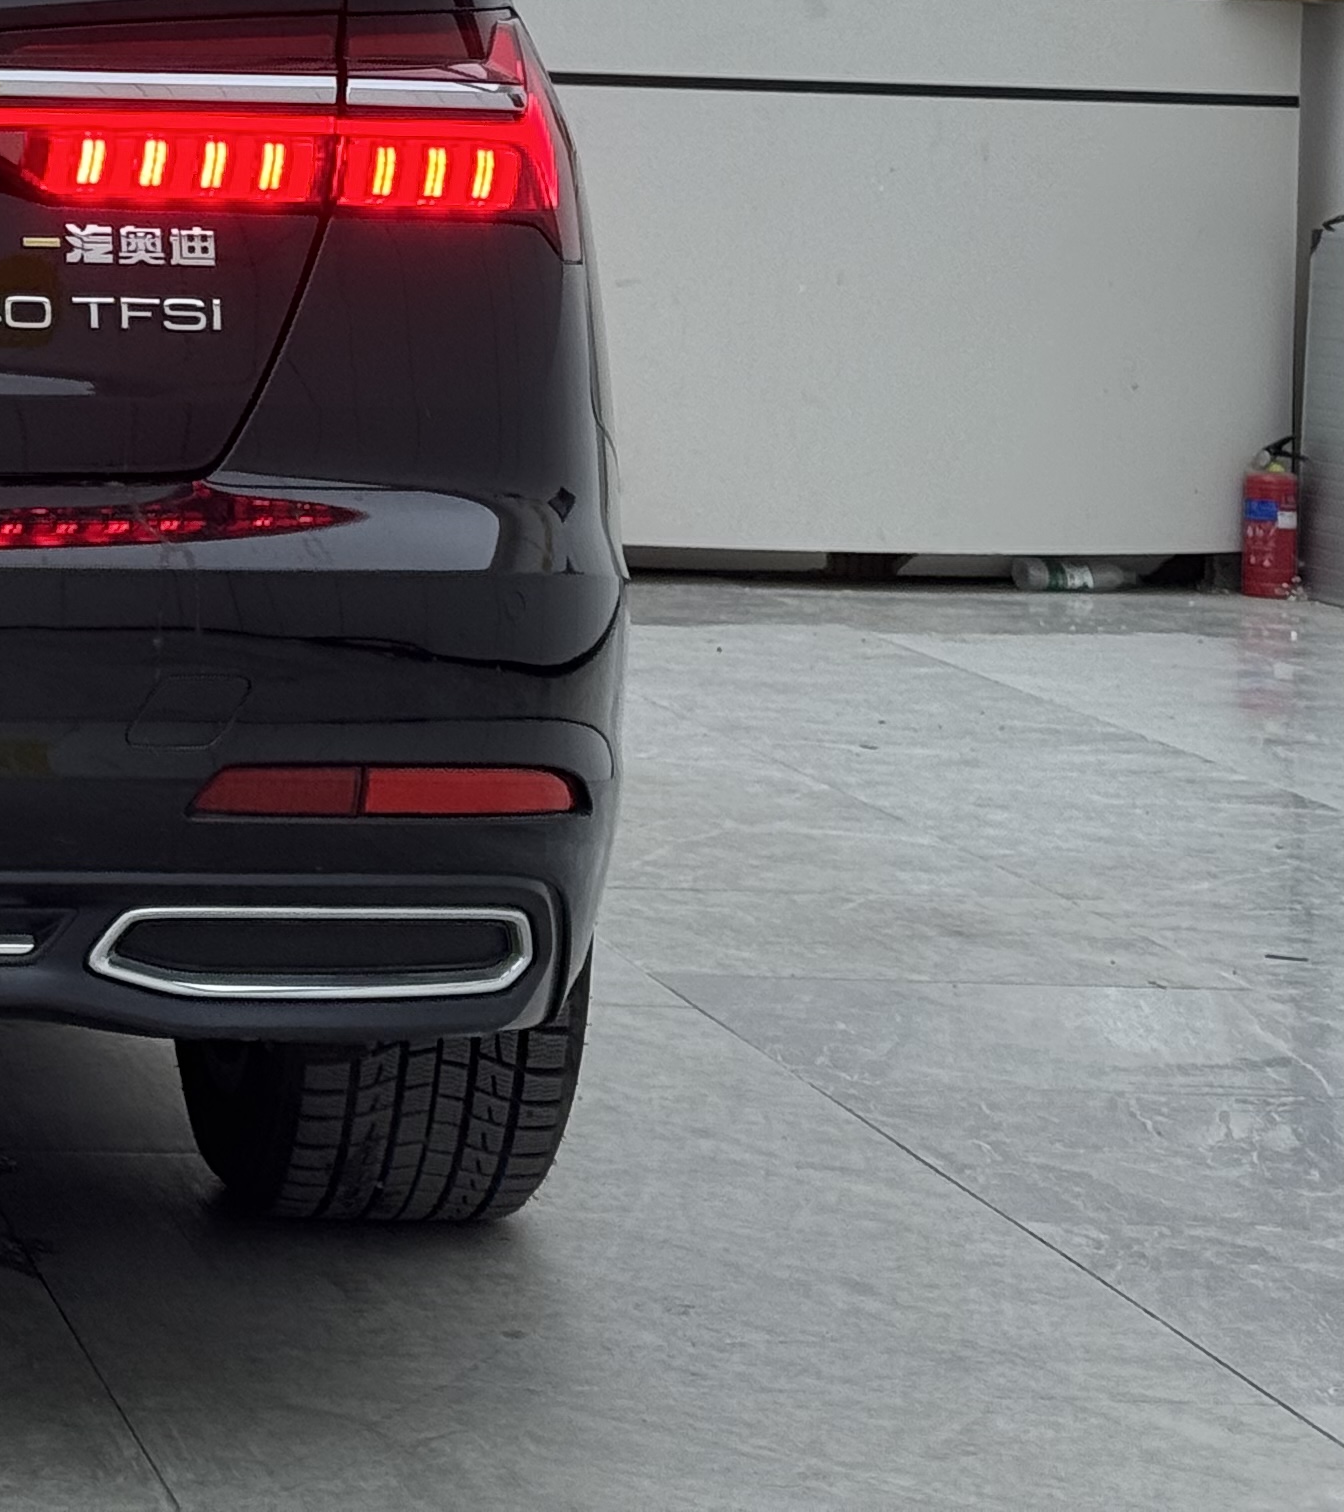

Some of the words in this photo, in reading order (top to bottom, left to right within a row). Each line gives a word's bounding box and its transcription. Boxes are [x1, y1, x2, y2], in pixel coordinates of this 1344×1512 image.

[21, 223, 217, 266] 一汽奥迪
[71, 296, 222, 331] TFSI
